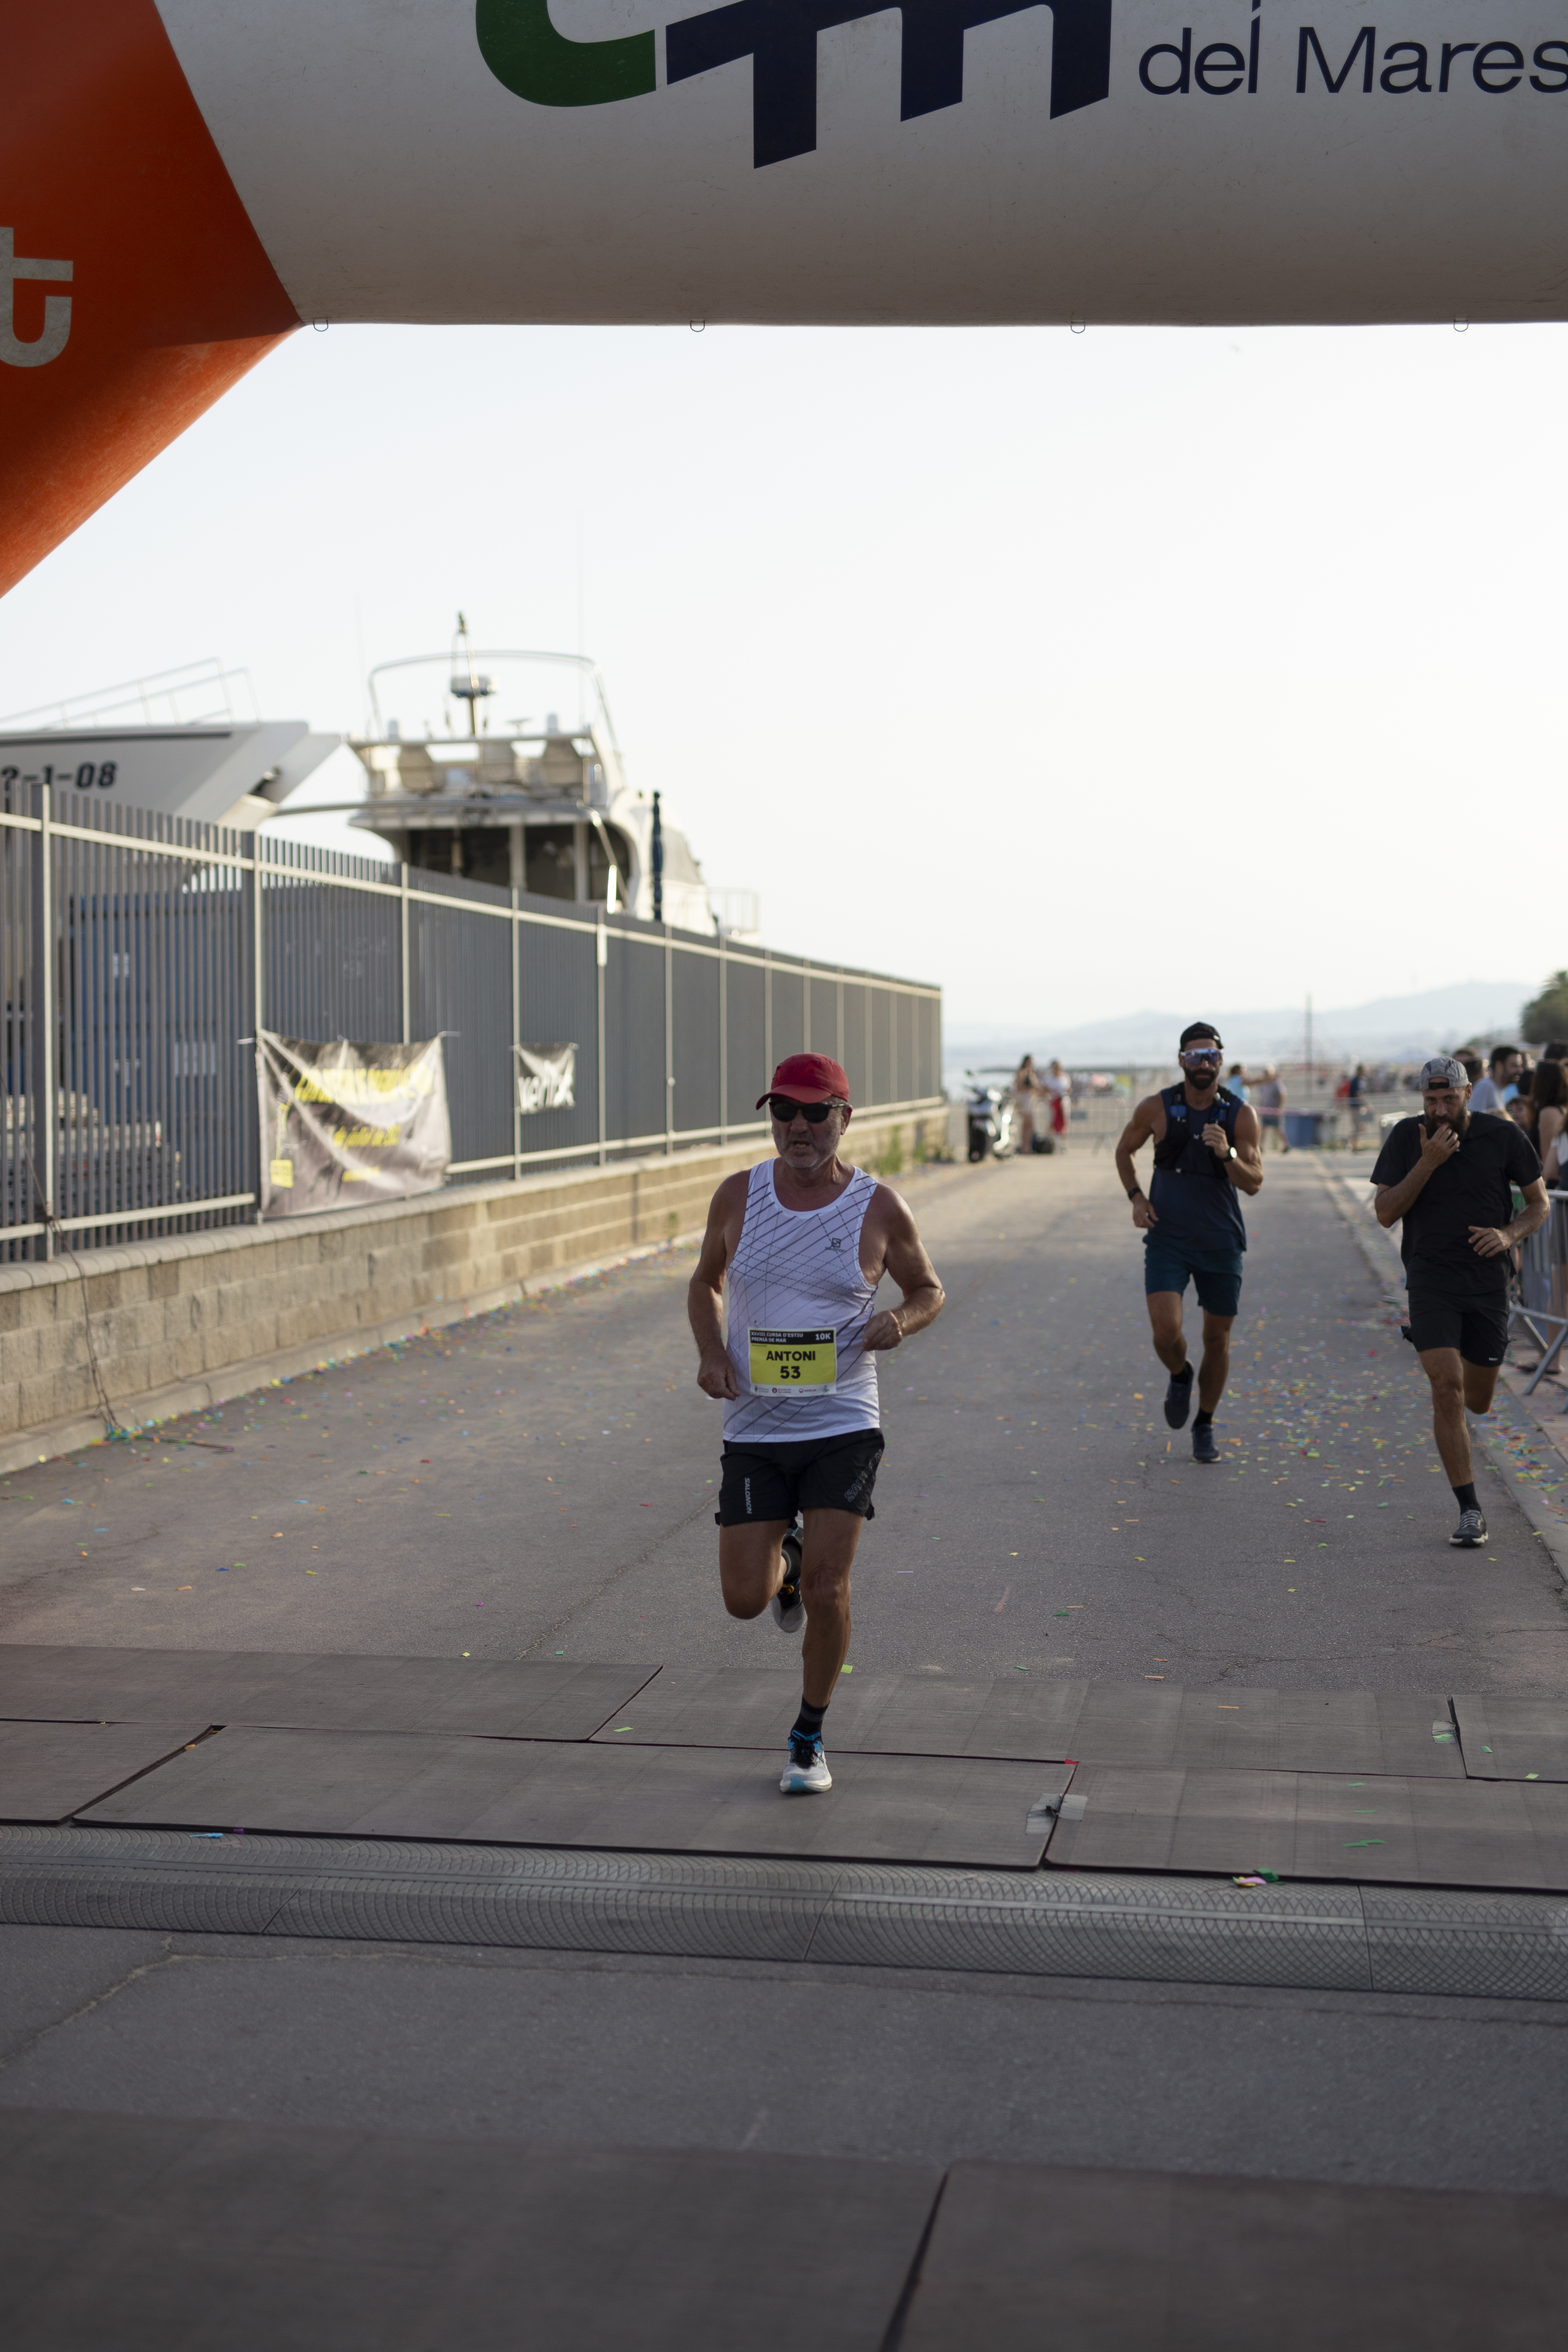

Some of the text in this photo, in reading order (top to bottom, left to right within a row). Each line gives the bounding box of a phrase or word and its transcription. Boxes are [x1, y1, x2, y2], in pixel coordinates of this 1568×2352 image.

[1139, 0, 1261, 95] del
[1295, 26, 1568, 95] Mares
[766, 1351, 816, 1361] ANTONI
[780, 1366, 801, 1379] 53
